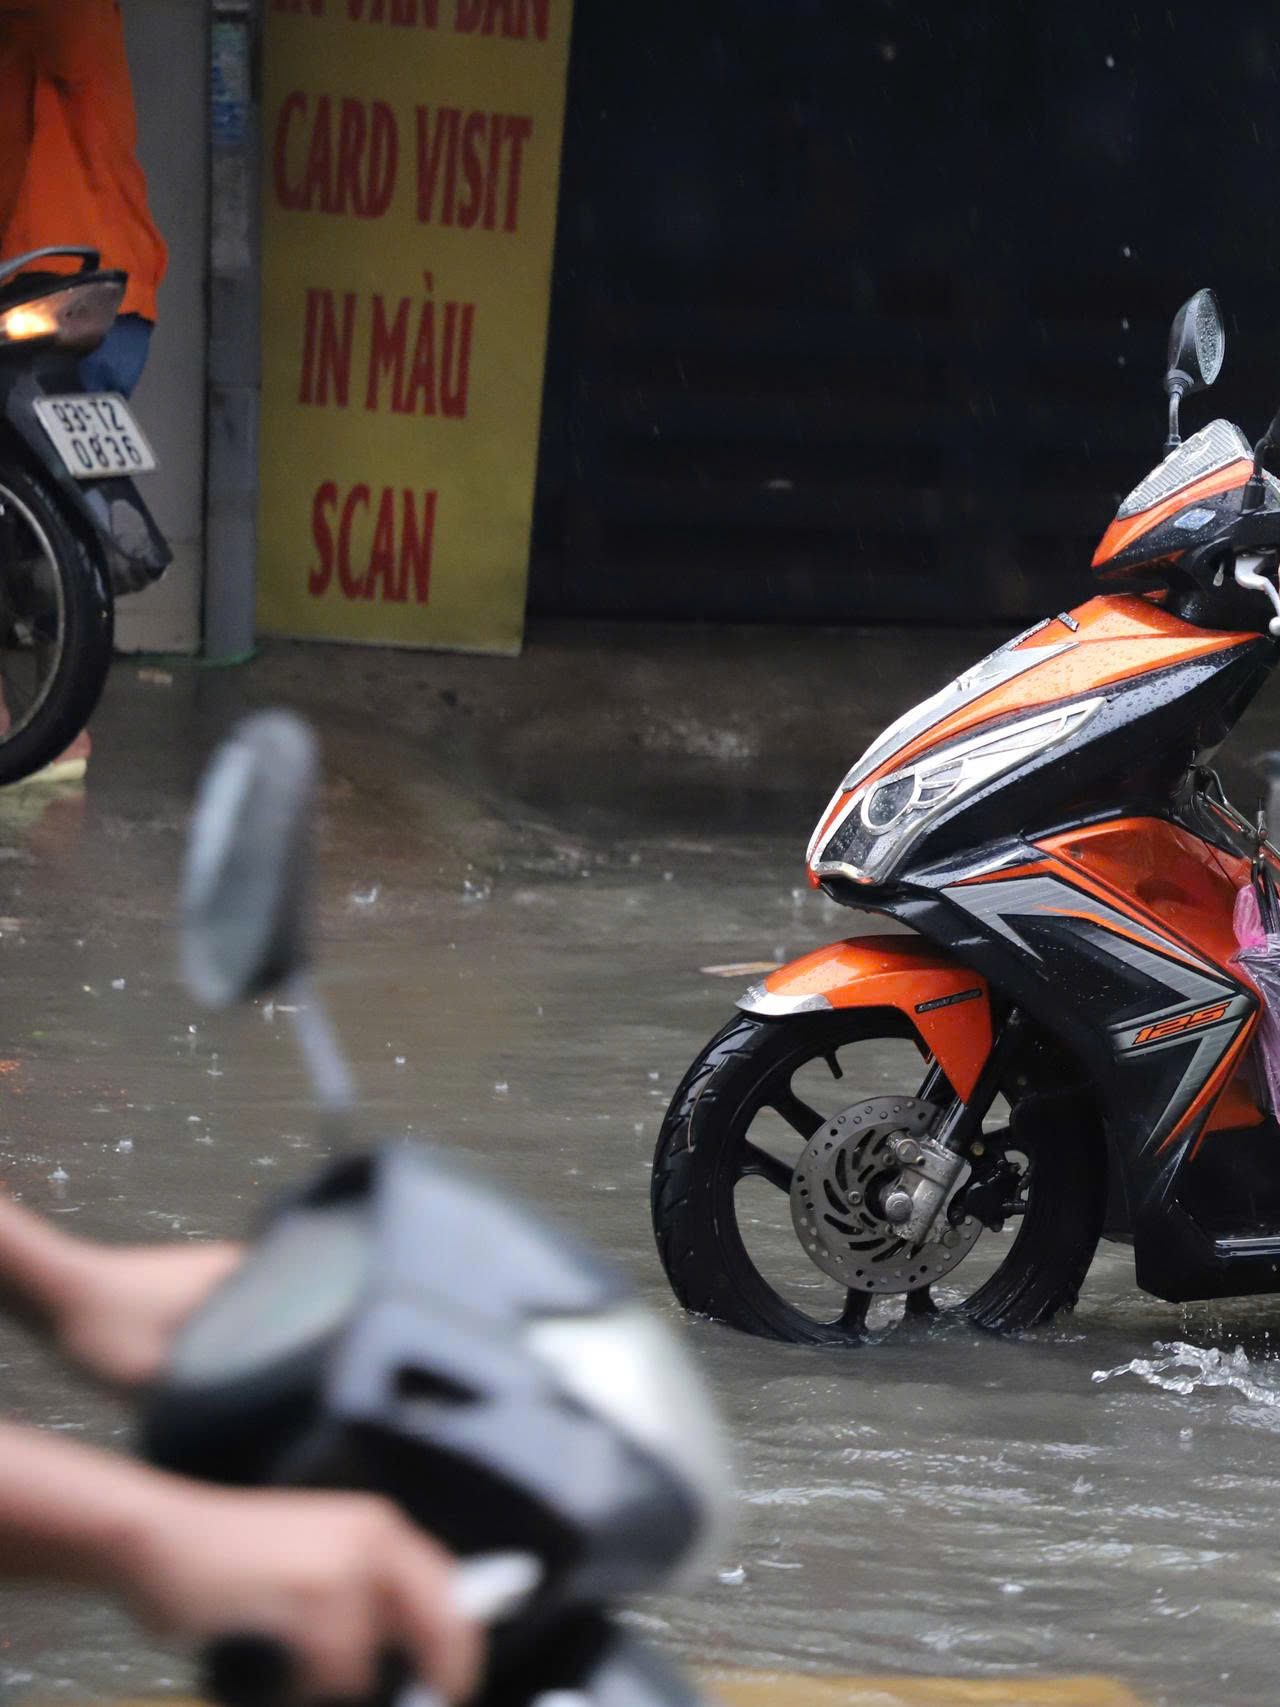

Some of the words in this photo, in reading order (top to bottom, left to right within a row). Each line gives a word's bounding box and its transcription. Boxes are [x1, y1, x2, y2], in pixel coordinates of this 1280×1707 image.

[272, 90, 401, 219] CARD
[414, 104, 534, 233] VISIT
[300, 287, 356, 409] IN
[365, 271, 475, 420] MÀU
[72, 434, 142, 469] 0836
[308, 480, 438, 607] SCAN
[1131, 1001, 1232, 1046] 125
